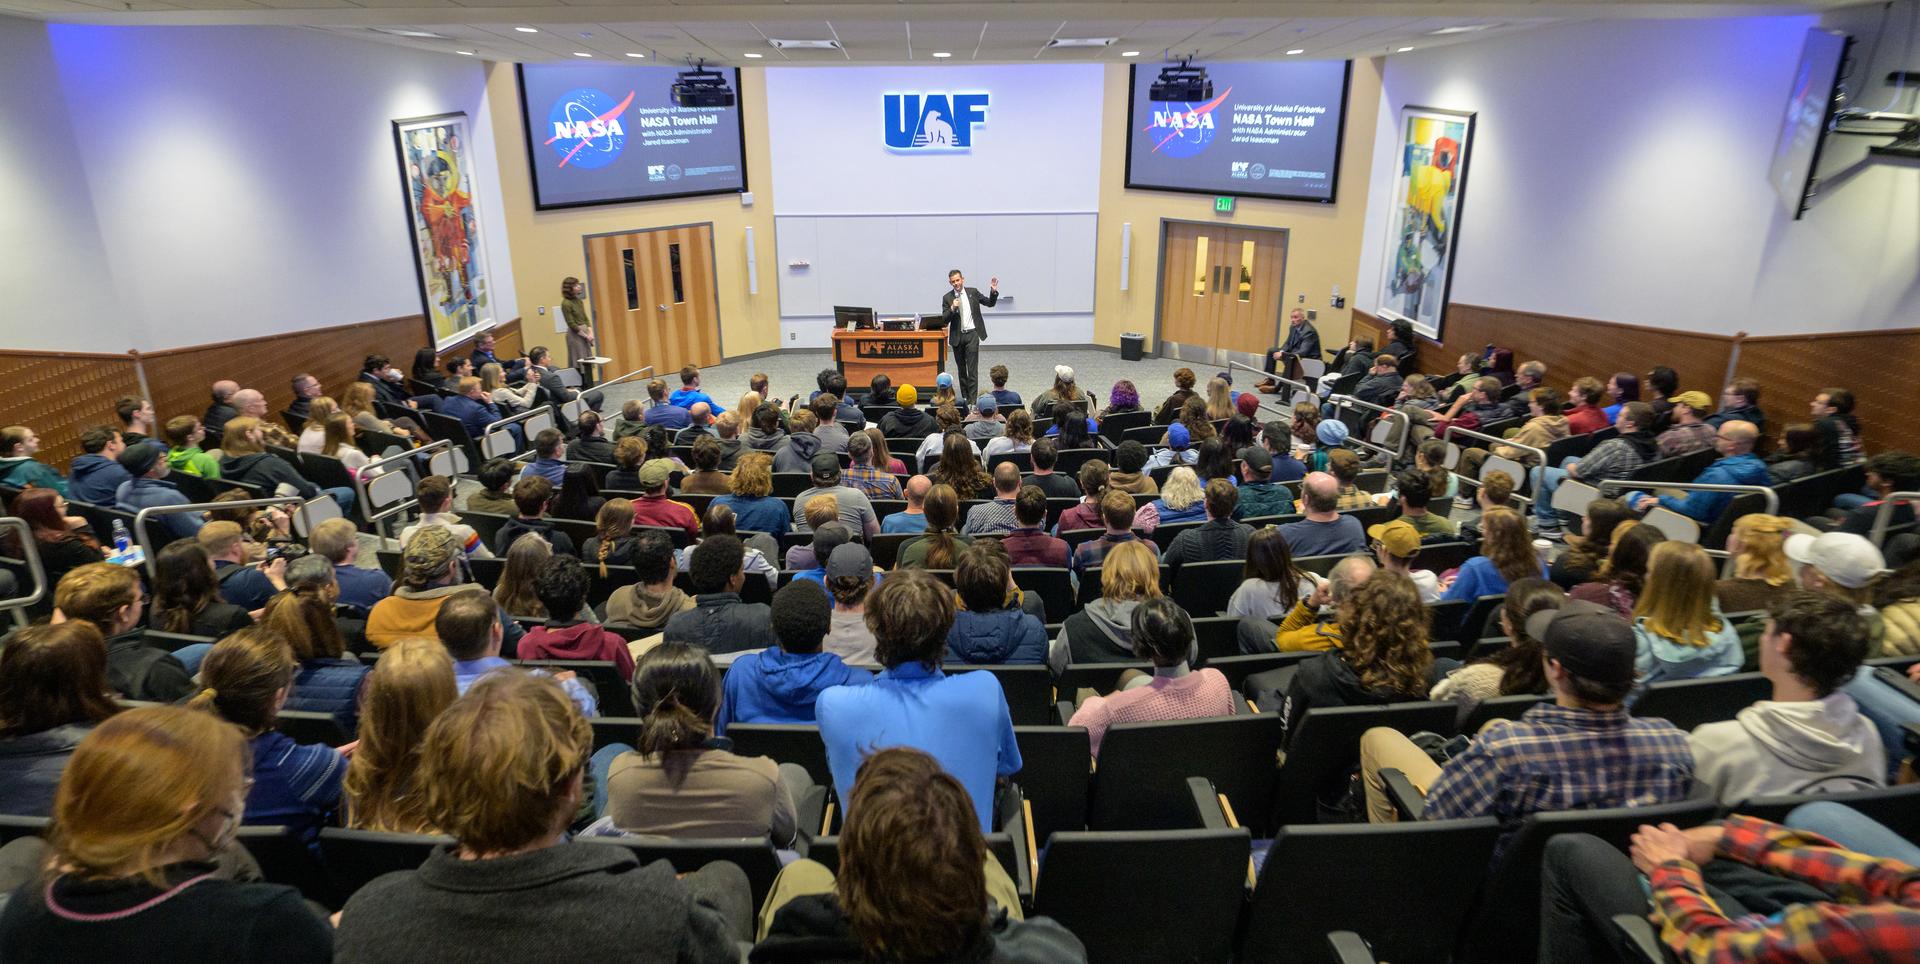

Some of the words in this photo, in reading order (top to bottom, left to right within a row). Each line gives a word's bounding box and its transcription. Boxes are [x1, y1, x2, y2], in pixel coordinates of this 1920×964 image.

[1234, 103, 1264, 113] University
[640, 116, 670, 128] NASA
[671, 115, 698, 126] Town
[699, 114, 718, 125] Hall
[884, 94, 989, 148] UAF
[1153, 111, 1215, 129] NASA
[1233, 113, 1263, 125] NASA
[1264, 114, 1293, 126] Town
[1293, 116, 1315, 127] Hall
[552, 119, 624, 139] NASA
[655, 129, 673, 137] NASA
[673, 128, 712, 136] Administrator
[1246, 127, 1264, 135] NASA
[1264, 127, 1307, 137] Administrator
[1231, 135, 1249, 143] Jared
[1216, 198, 1233, 211] EXIT
